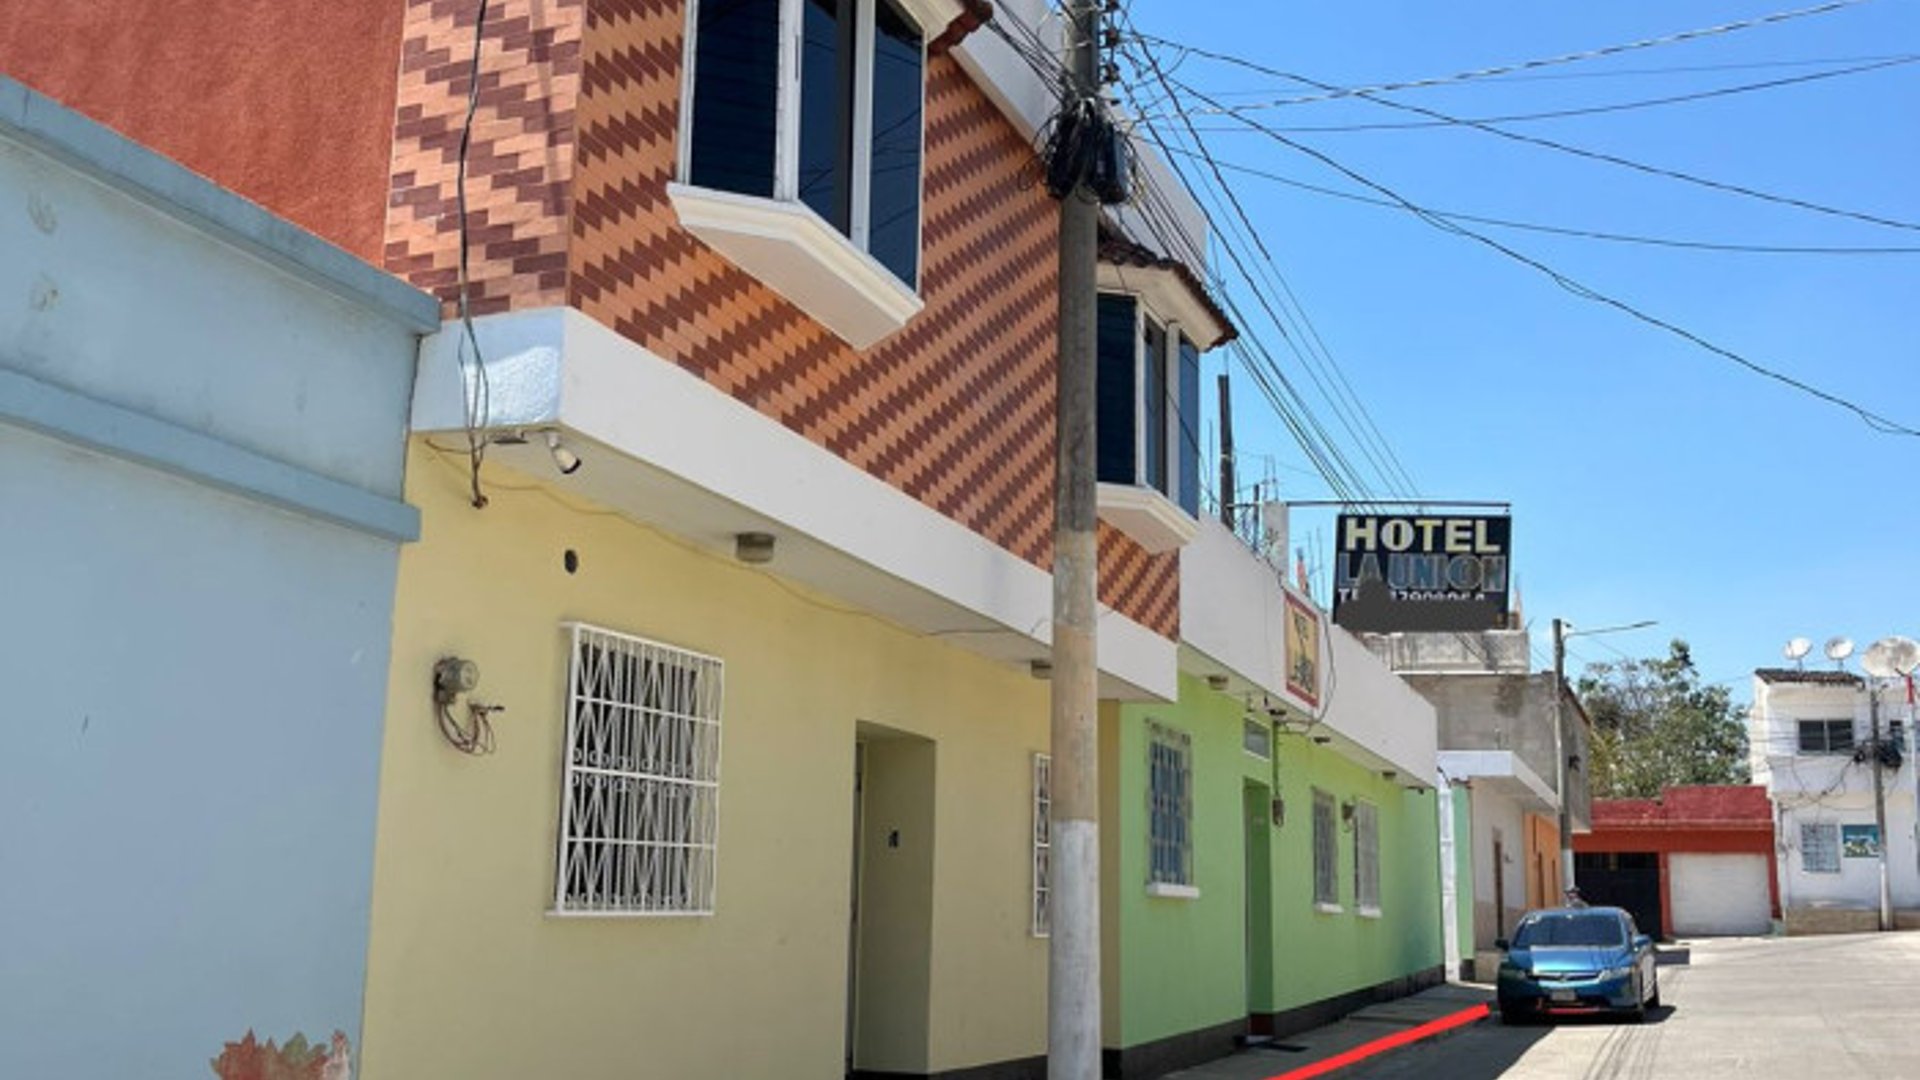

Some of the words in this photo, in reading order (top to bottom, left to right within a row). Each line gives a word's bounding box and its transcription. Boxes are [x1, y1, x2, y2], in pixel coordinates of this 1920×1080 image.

[1345, 517, 1501, 552] HOTEL
[1338, 553, 1384, 588] LA
[1387, 553, 1507, 592] UNION
